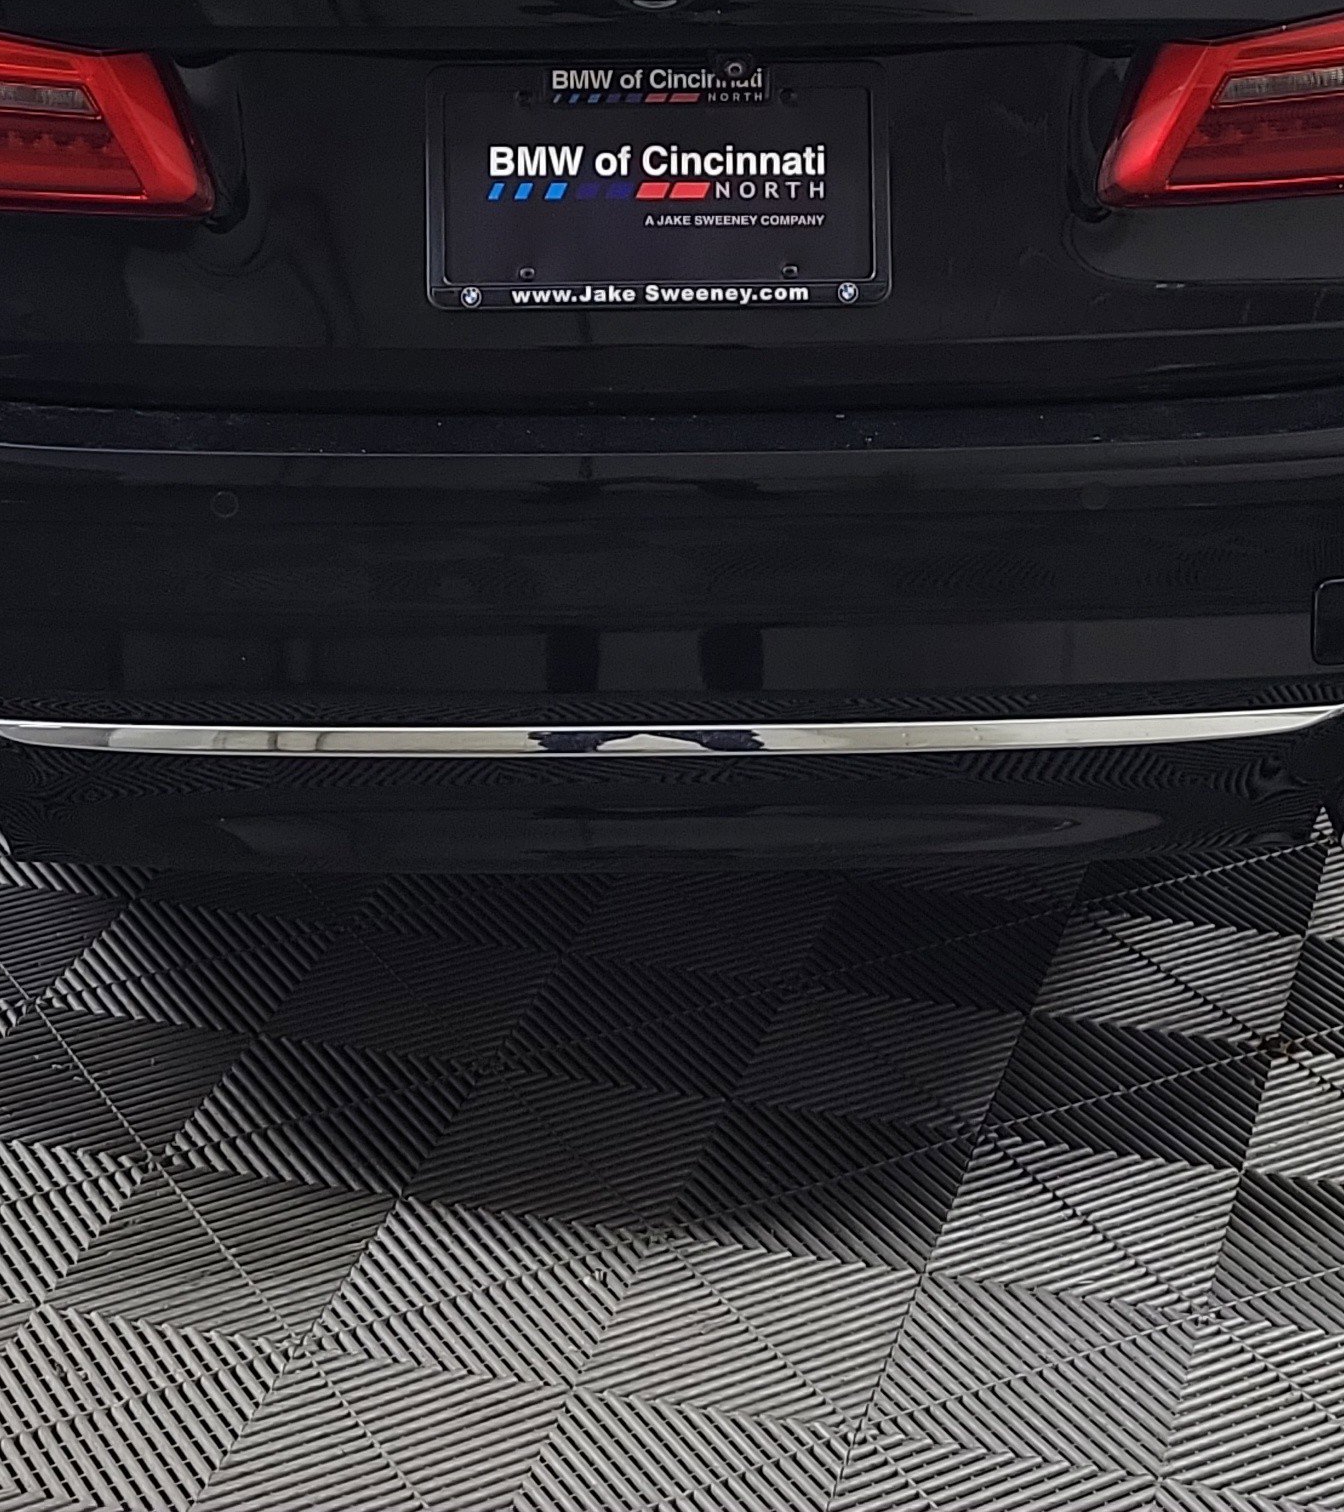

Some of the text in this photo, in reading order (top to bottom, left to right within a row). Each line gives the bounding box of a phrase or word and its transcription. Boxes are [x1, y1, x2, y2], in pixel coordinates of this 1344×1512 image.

[552, 69, 613, 90] BMW
[619, 69, 643, 90] of
[708, 92, 763, 103] NORTH
[489, 145, 825, 176] BMW of Cincinnati
[715, 181, 825, 199] NORTH
[645, 215, 825, 226] A JAKE SWEENEY COMPANY
[512, 284, 809, 306] www.Jake Sweeney.com
